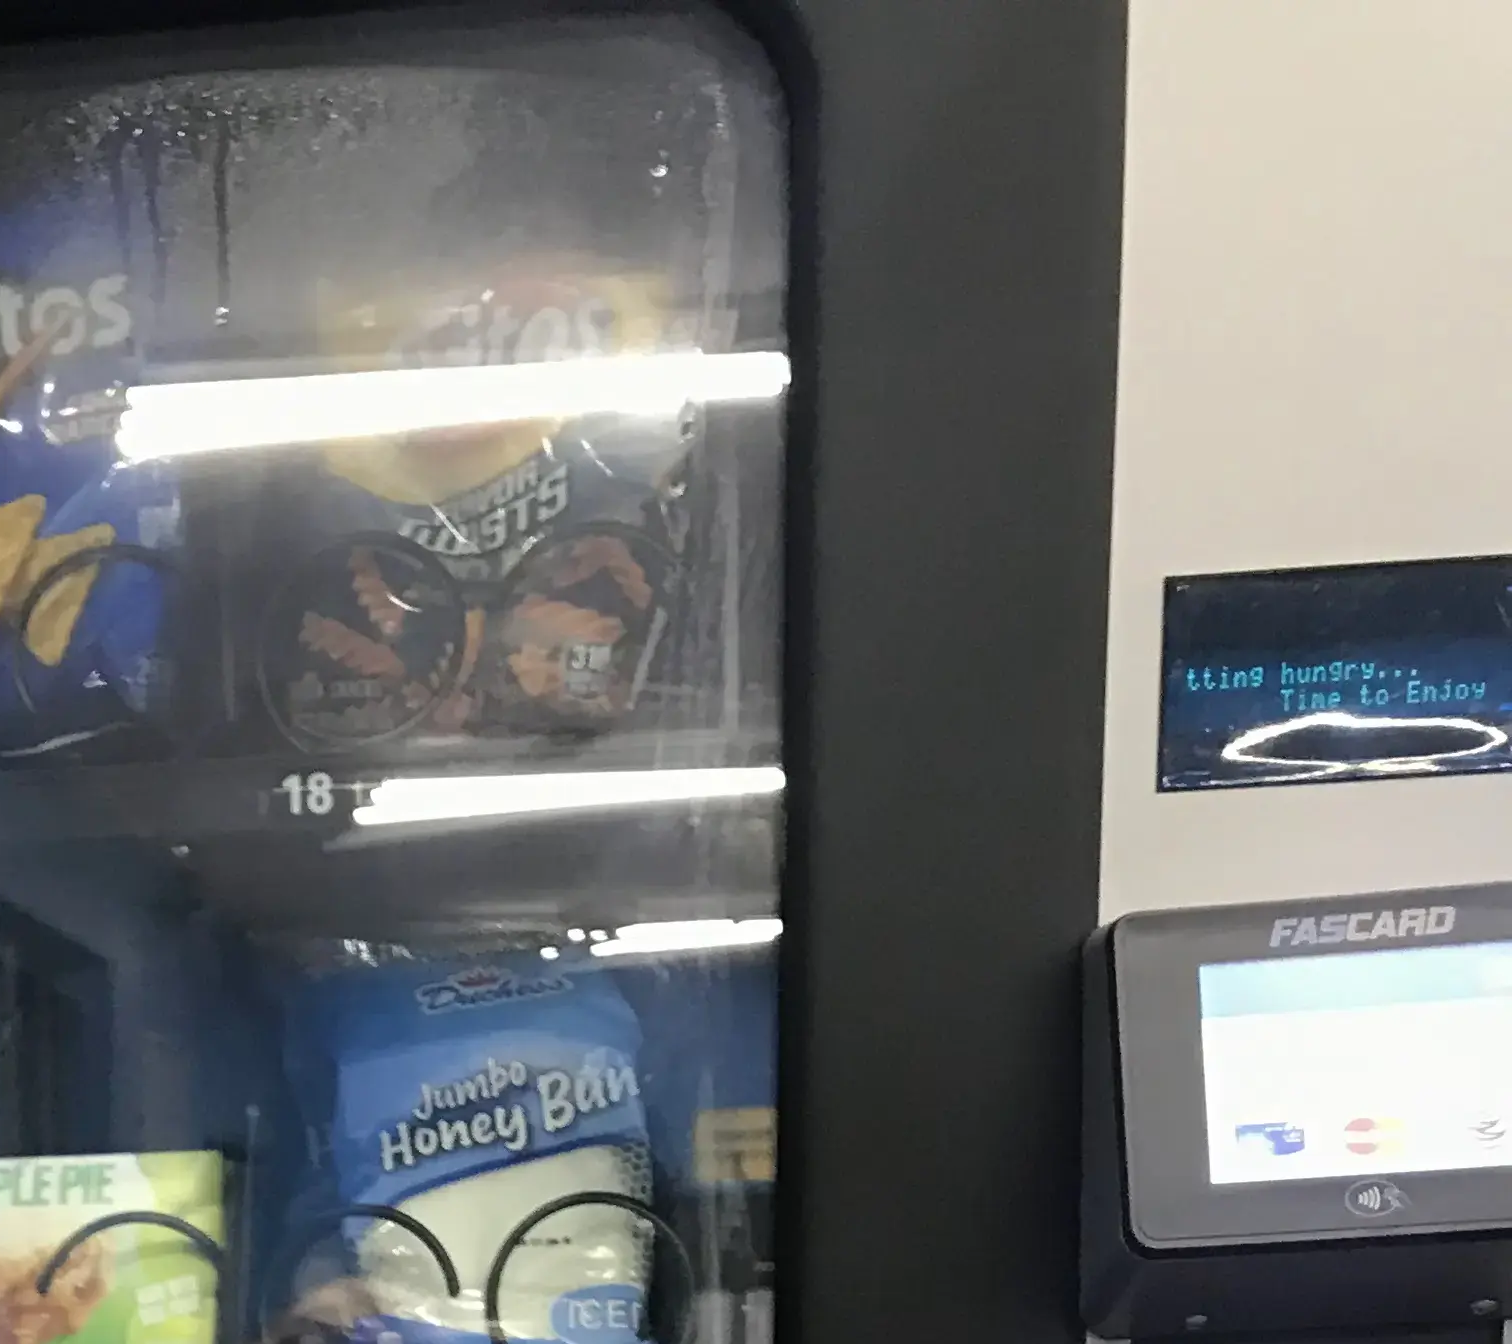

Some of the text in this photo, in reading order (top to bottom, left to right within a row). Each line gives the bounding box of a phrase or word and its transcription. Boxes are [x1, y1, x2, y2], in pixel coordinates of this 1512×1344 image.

[1186, 665, 1265, 691] tting
[1359, 684, 1390, 707] to
[1405, 679, 1488, 704] Enjoy
[281, 769, 335, 816] 18
[1269, 905, 1457, 948] FASCARD
[412, 1056, 528, 1122] Jumbo
[379, 1060, 641, 1172] Honey Bun
[58, 1163, 116, 1206] PIE
